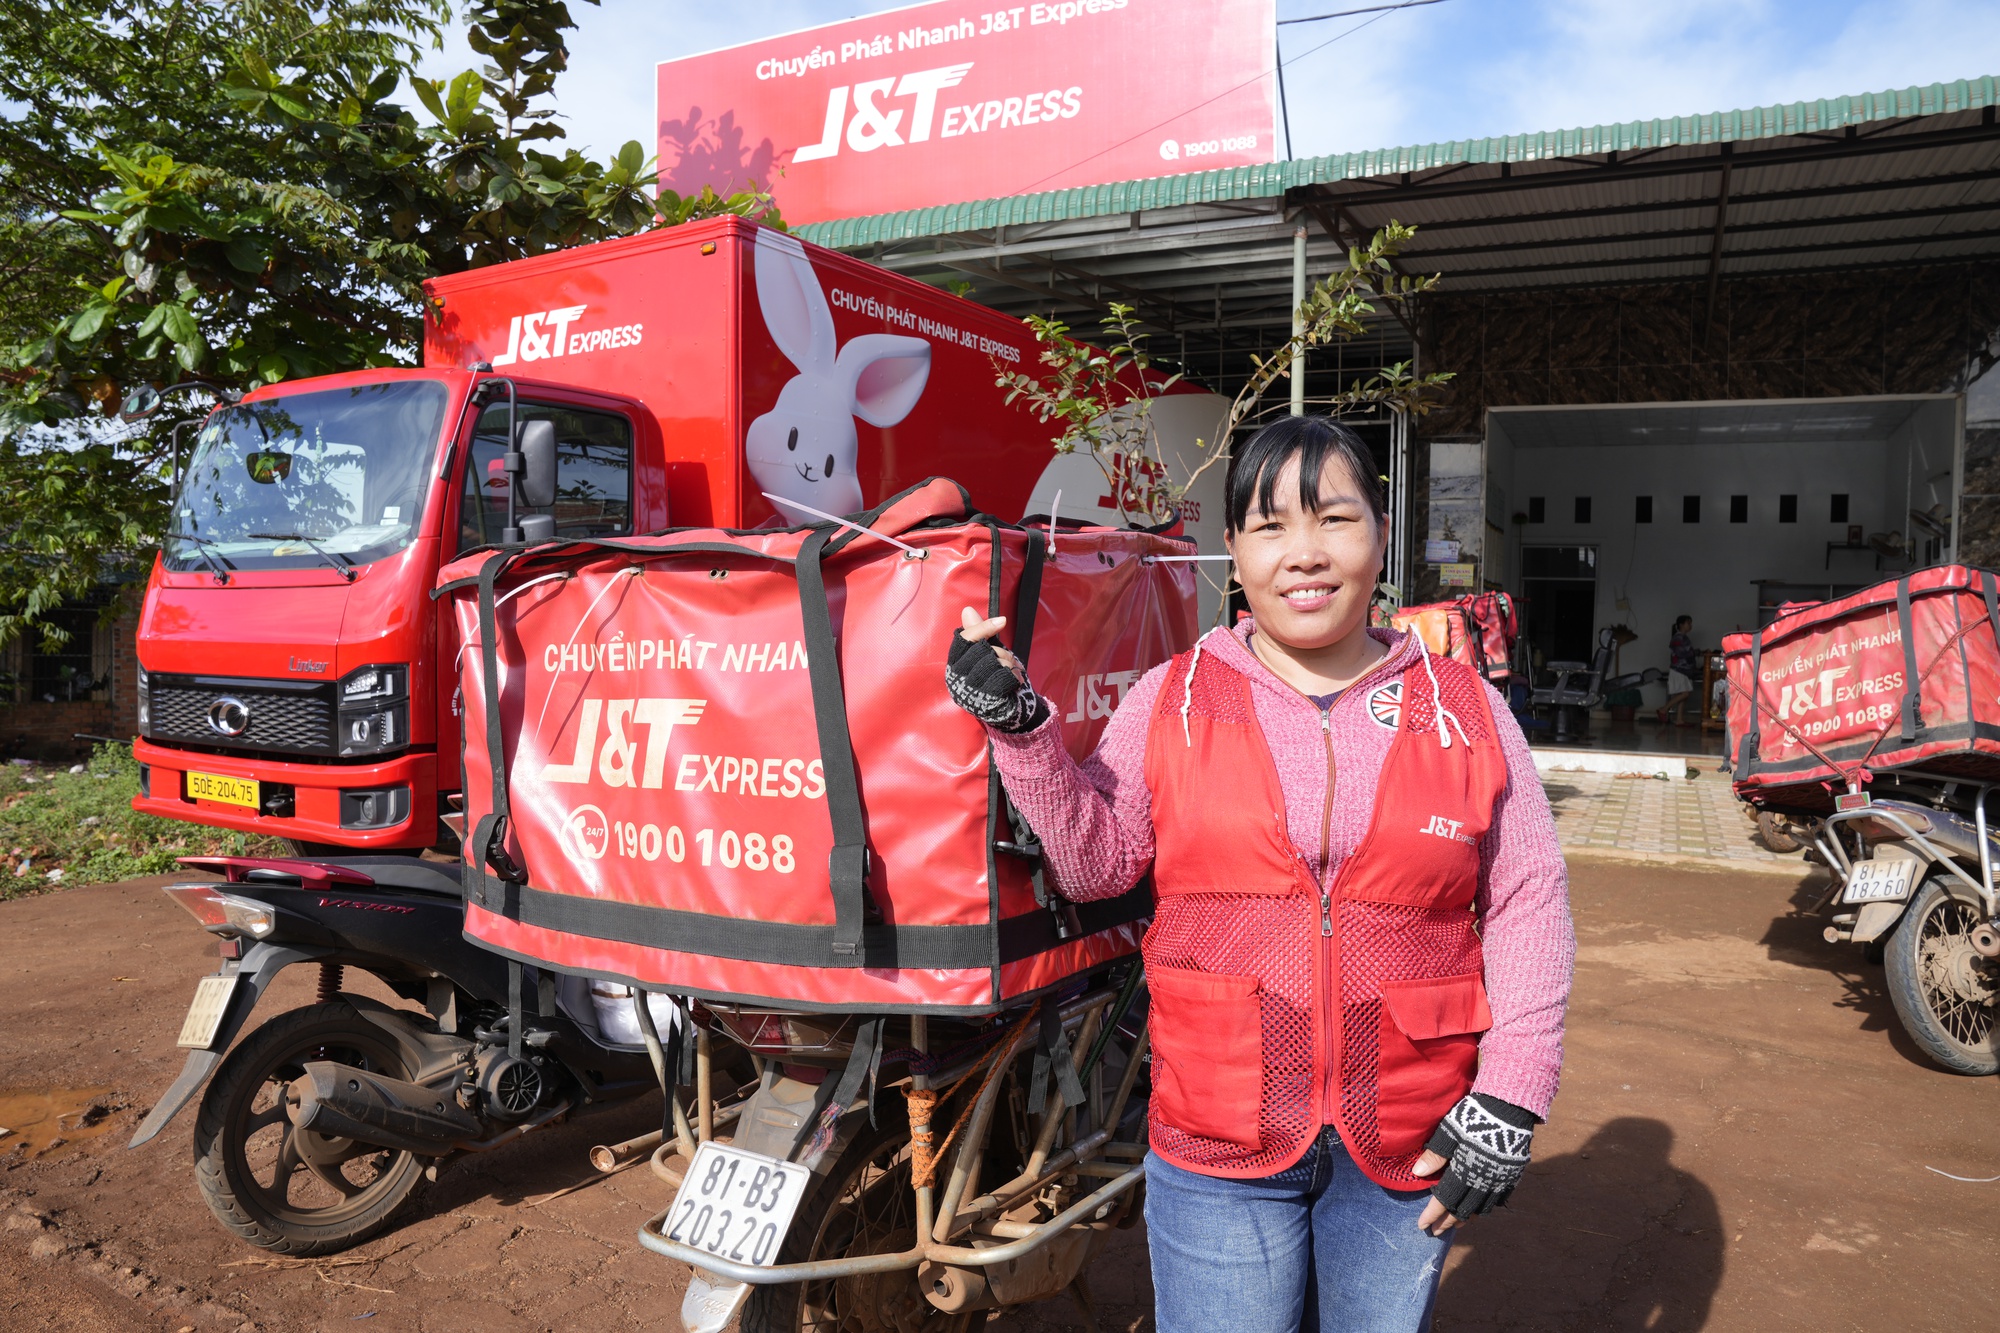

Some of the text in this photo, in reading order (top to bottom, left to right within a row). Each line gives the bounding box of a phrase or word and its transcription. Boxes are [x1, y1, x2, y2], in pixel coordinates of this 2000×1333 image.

[756, 0, 1128, 80] Chuyển Phát Nhanh J&T Express
[792, 61, 1083, 163] J&T EXPRESS
[1183, 135, 1258, 157] 1900 1088
[491, 304, 644, 367] J&T EXPRESS
[831, 288, 1021, 364] CHUYỂN PHÁT NHANH J&T EXPRESS
[544, 630, 809, 673] CHUYỂN PHÁT NHAN
[1761, 655, 1814, 683] CHUYỂN
[1850, 628, 1902, 655] NHANH
[1065, 669, 1141, 723] J&T
[1770, 665, 1903, 724] J&T EXPRESS
[1803, 703, 1894, 738] 1900 1088
[539, 698, 827, 800] J&T EXPRESS
[586, 820, 796, 874] 24/7 1900 1088
[1419, 815, 1464, 840] J&T
[1851, 879, 1905, 899] 182.60
[1859, 861, 1905, 880] 81-T1
[701, 1155, 787, 1213] 81-B3
[669, 1199, 778, 1265] 203.20
